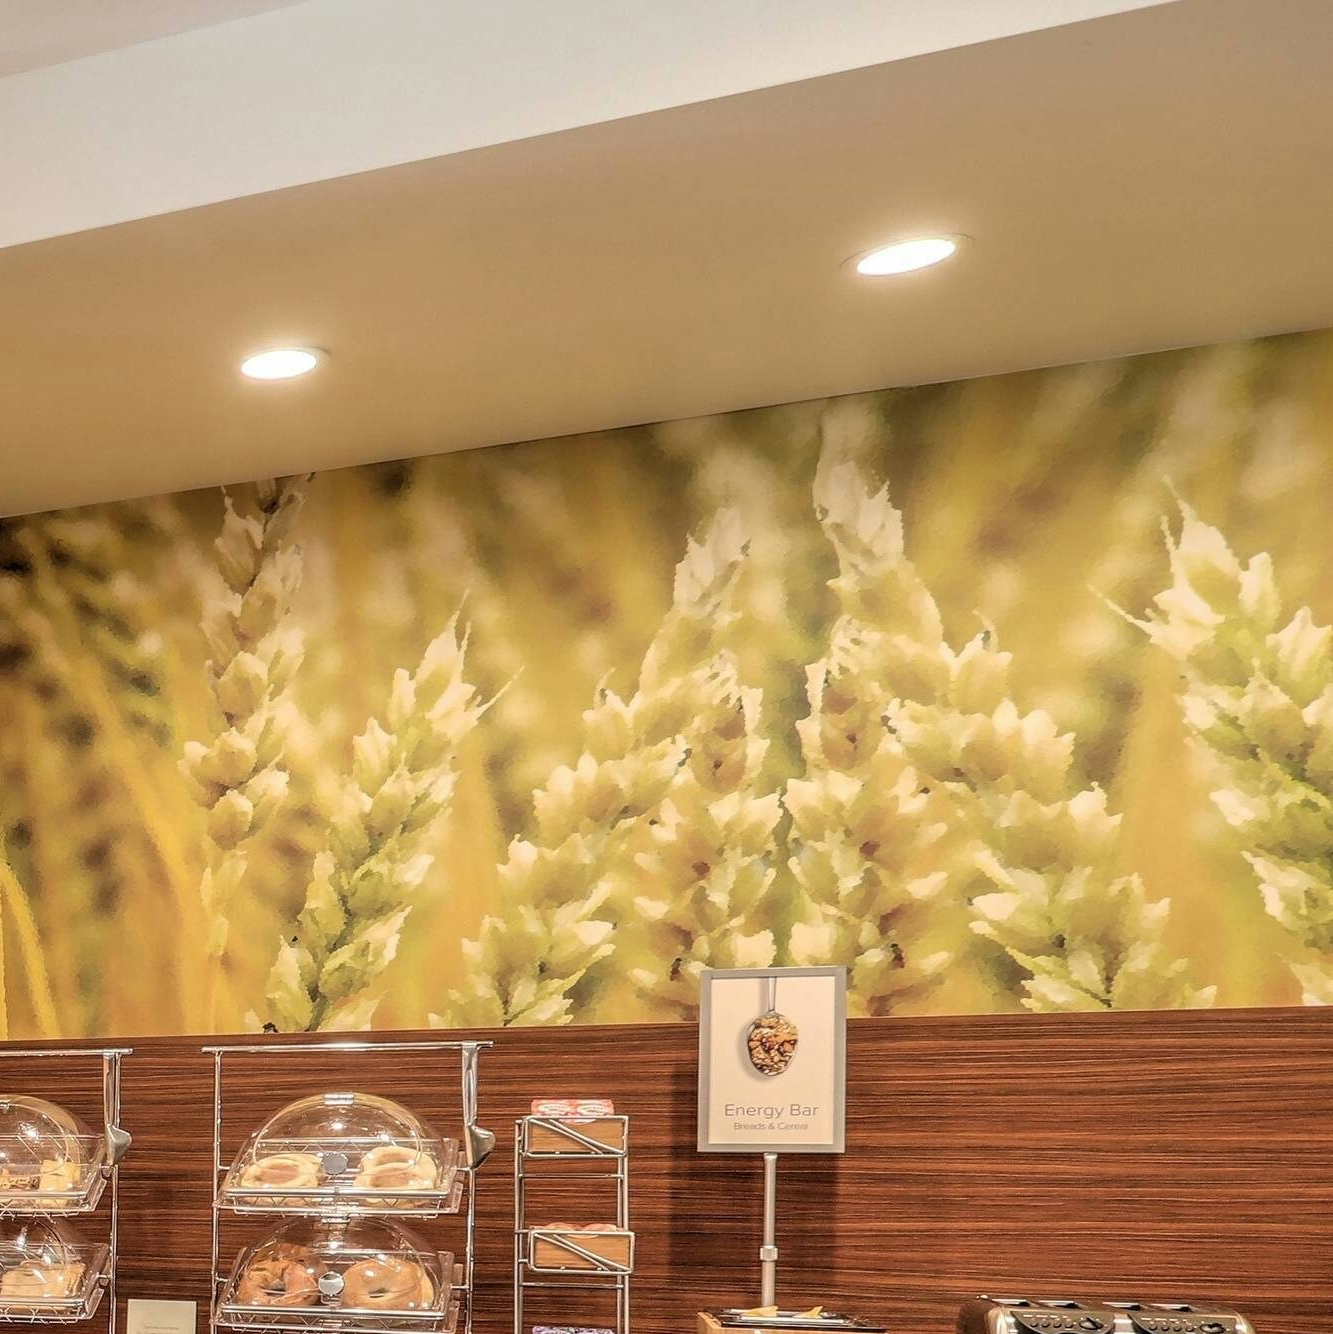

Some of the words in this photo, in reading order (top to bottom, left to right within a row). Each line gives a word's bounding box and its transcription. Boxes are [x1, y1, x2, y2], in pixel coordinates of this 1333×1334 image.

[724, 1103, 785, 1119] Energy
[789, 1103, 820, 1116] Bar
[733, 1122, 766, 1130] Breads
[777, 1122, 809, 1130] Cereal
